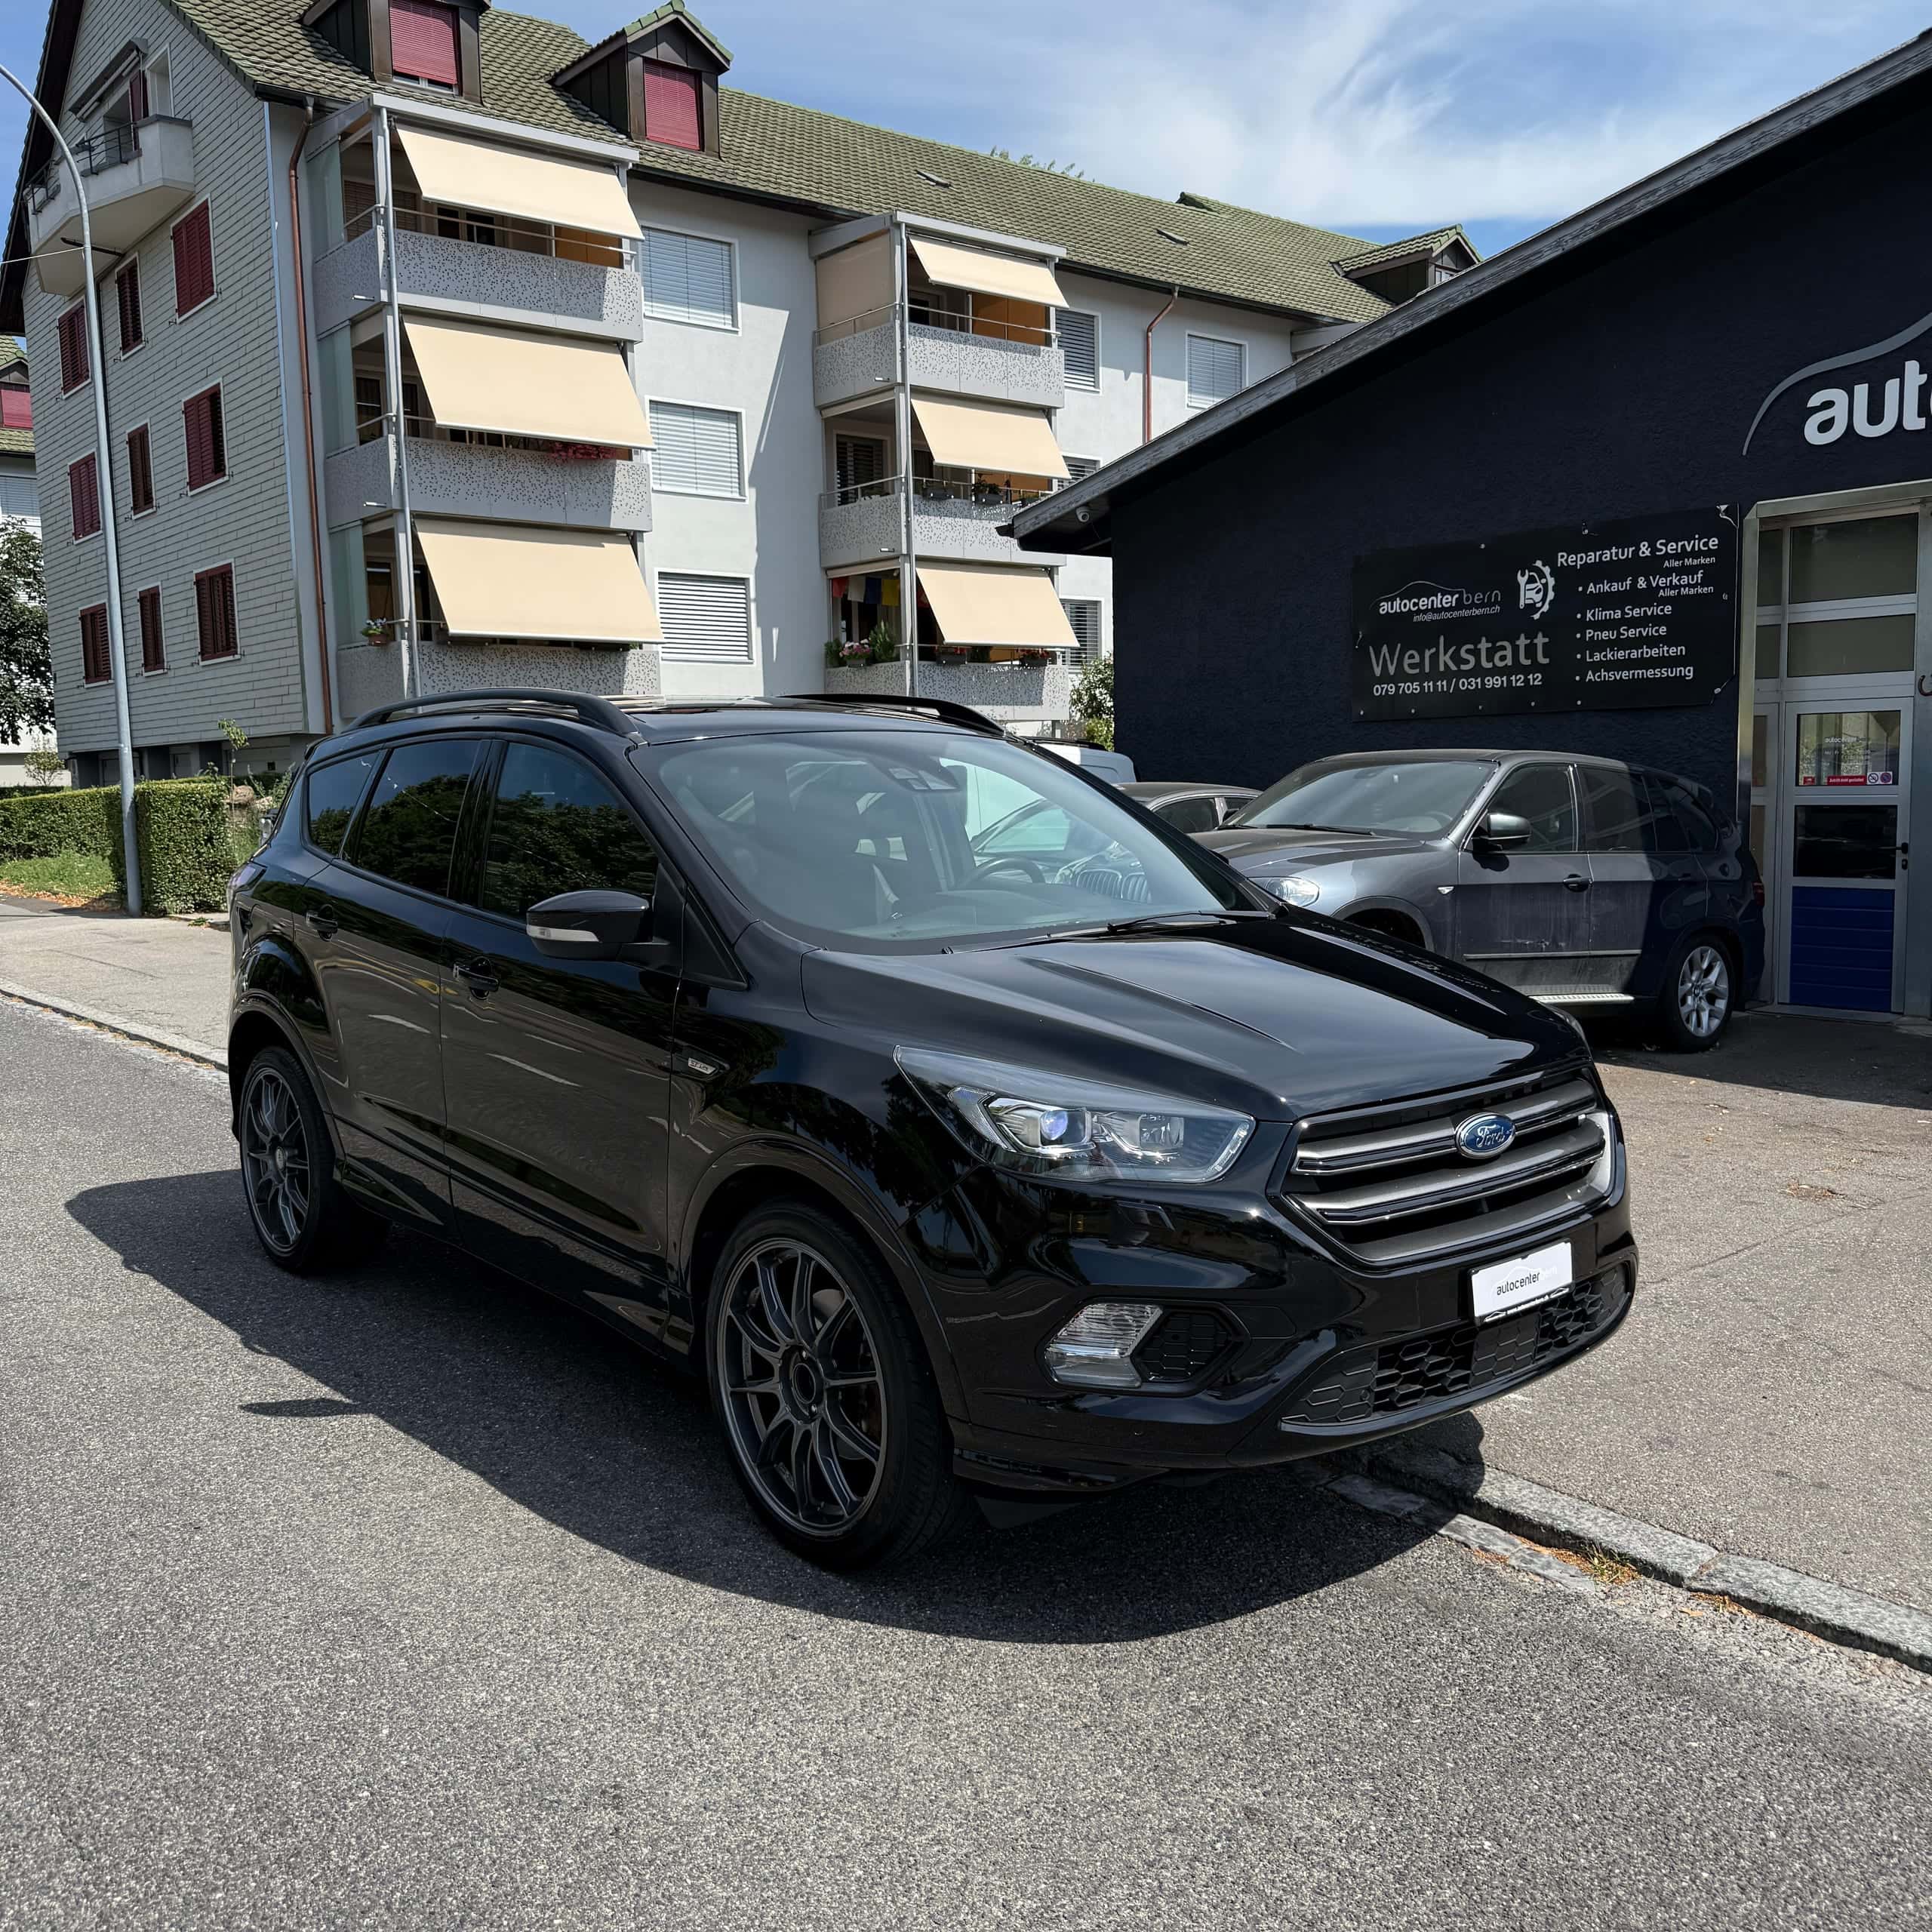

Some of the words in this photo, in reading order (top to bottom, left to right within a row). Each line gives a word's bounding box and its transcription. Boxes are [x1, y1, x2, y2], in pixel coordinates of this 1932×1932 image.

[1804, 360, 1932, 445] aut
[1558, 546, 1635, 570] Reparatur
[1638, 541, 1651, 557] &
[1655, 534, 1719, 555] Service
[1663, 559, 1683, 568] Aller
[1684, 555, 1715, 566] Marken
[1586, 577, 1632, 594] Ankauf
[1637, 576, 1647, 589] &
[1649, 570, 1703, 588] Verkauf
[1658, 588, 1679, 598] Aller
[1681, 586, 1714, 595] Marken
[1379, 592, 1459, 614] autocenter
[1463, 589, 1501, 605] bern
[1586, 608, 1621, 622] Klima
[1624, 602, 1672, 618] Service
[1413, 605, 1500, 623] info@autocenterbern.ch
[1586, 629, 1617, 641] Pneu
[1620, 623, 1667, 638] Service
[1369, 632, 1549, 677] Werkstatt
[1586, 644, 1685, 662] Lackierarbeiten
[1373, 684, 1395, 696] 079
[1398, 682, 1420, 694] 705
[1423, 681, 1434, 693] 11
[1436, 680, 1447, 692] 11
[1450, 678, 1457, 694] /
[1459, 677, 1481, 690] 031
[1484, 675, 1507, 688] 991
[1509, 674, 1524, 687] 12
[1527, 673, 1543, 685] 12
[1586, 666, 1694, 682] Achsvermessung
[1476, 1124, 1506, 1148] Ford
[1497, 1272, 1540, 1296] autocenter
